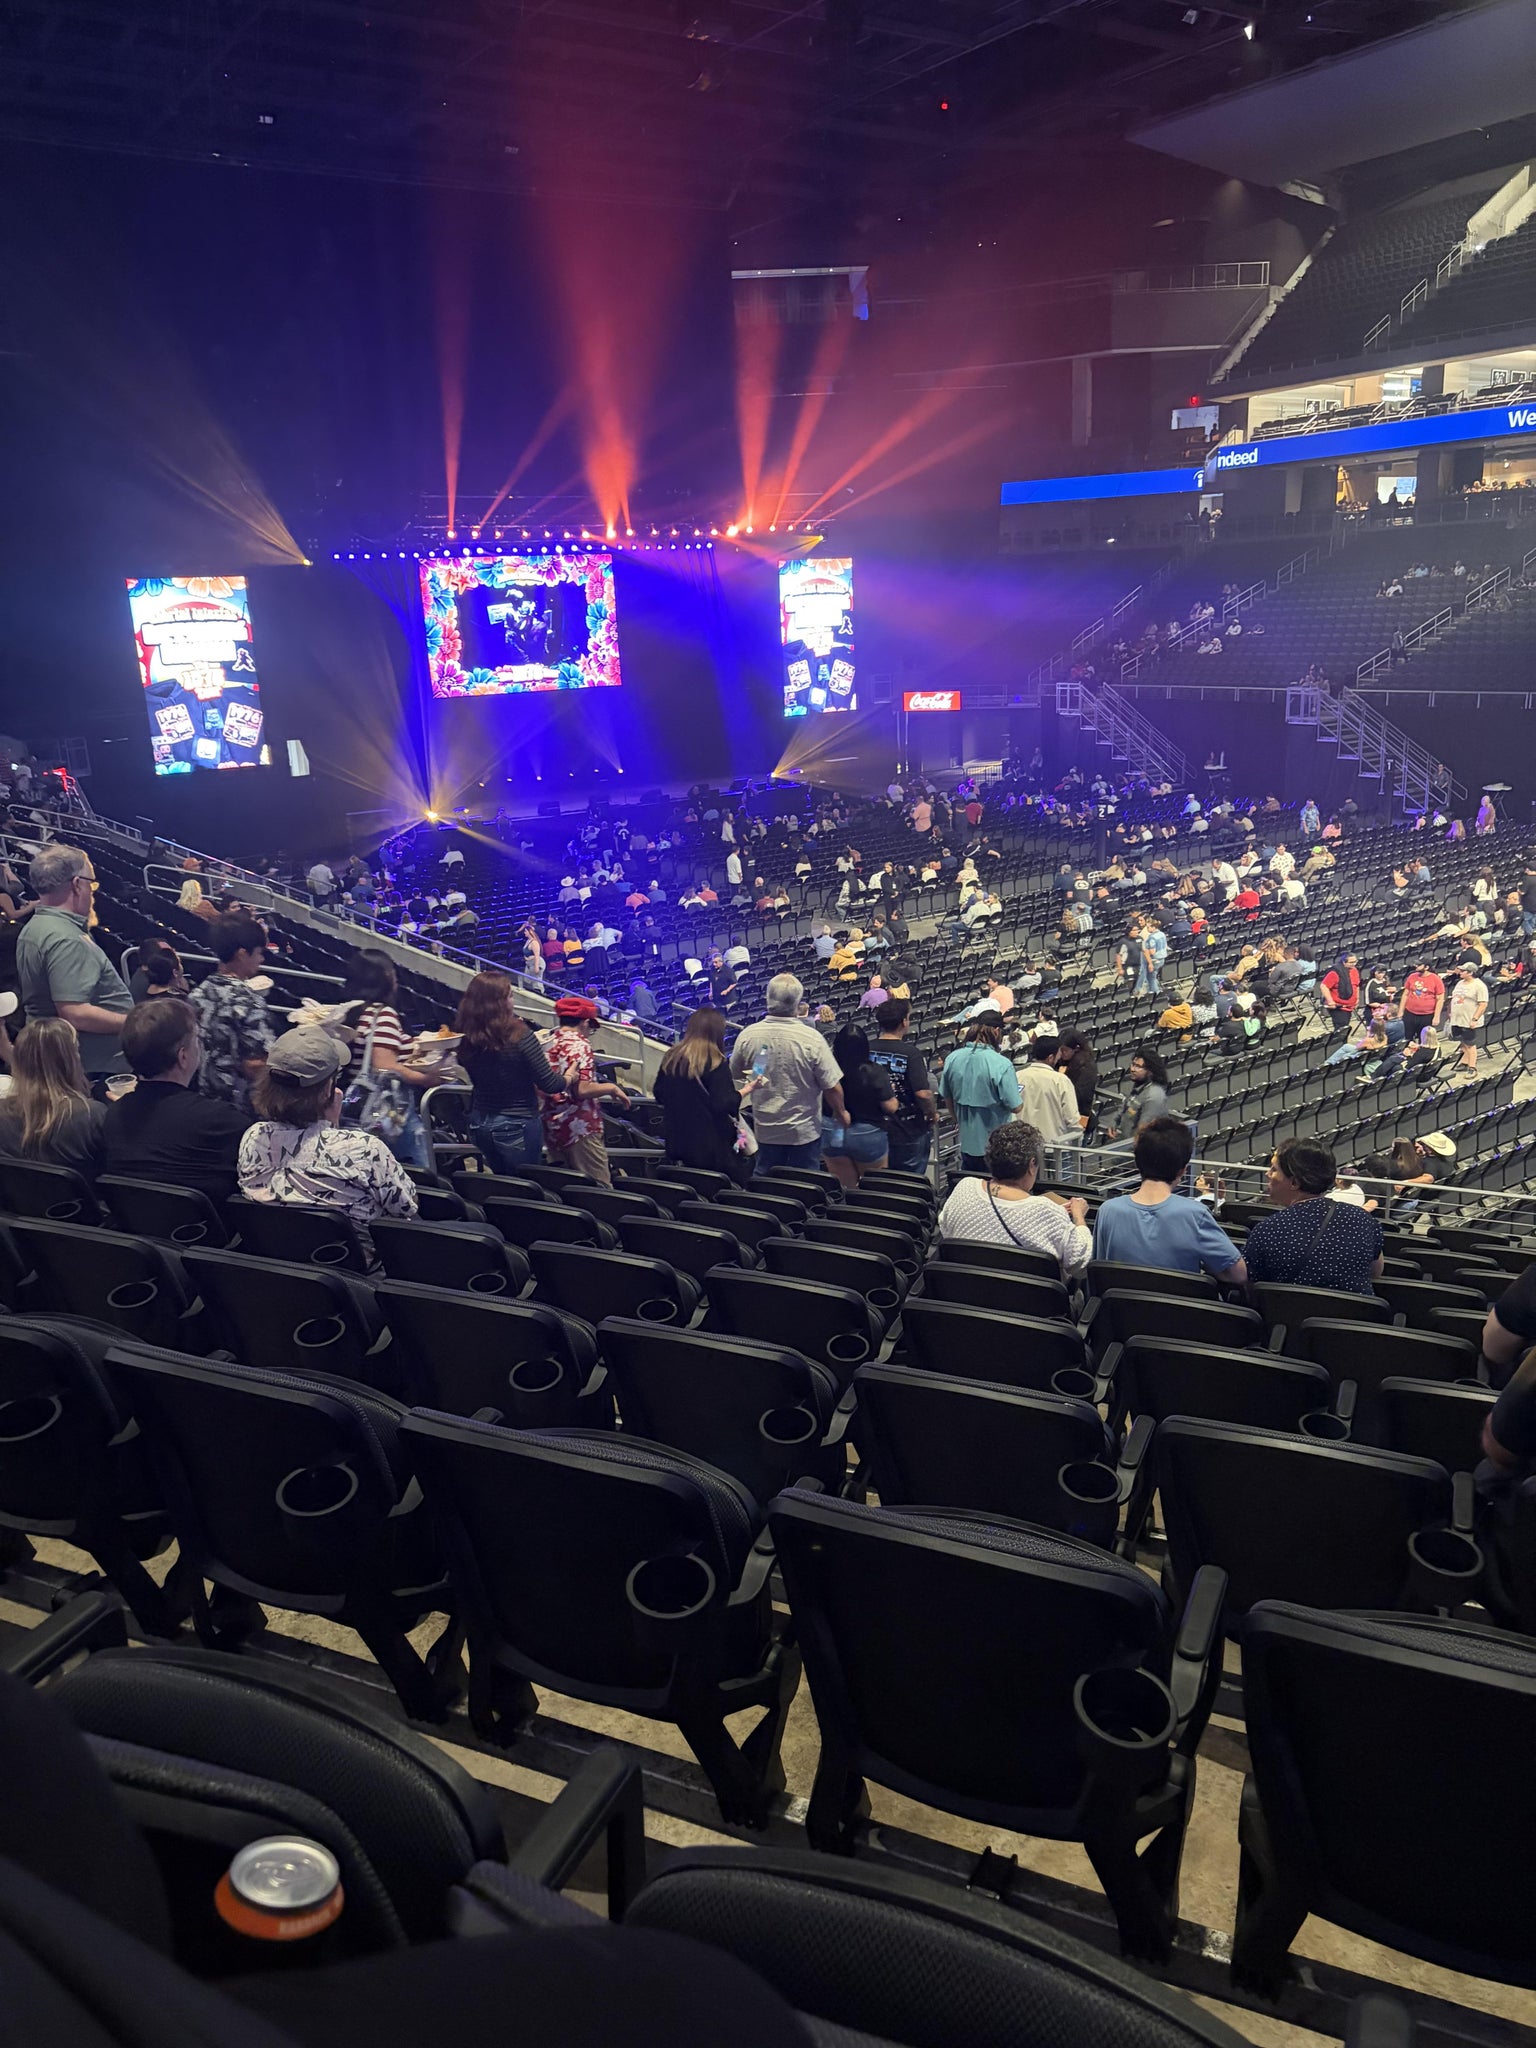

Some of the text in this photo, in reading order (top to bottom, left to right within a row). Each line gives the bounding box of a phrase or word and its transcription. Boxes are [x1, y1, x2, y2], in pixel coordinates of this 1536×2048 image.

[1508, 409, 1536, 428] We
[1217, 448, 1259, 468] ndeed
[1098, 808, 1105, 818] 2
